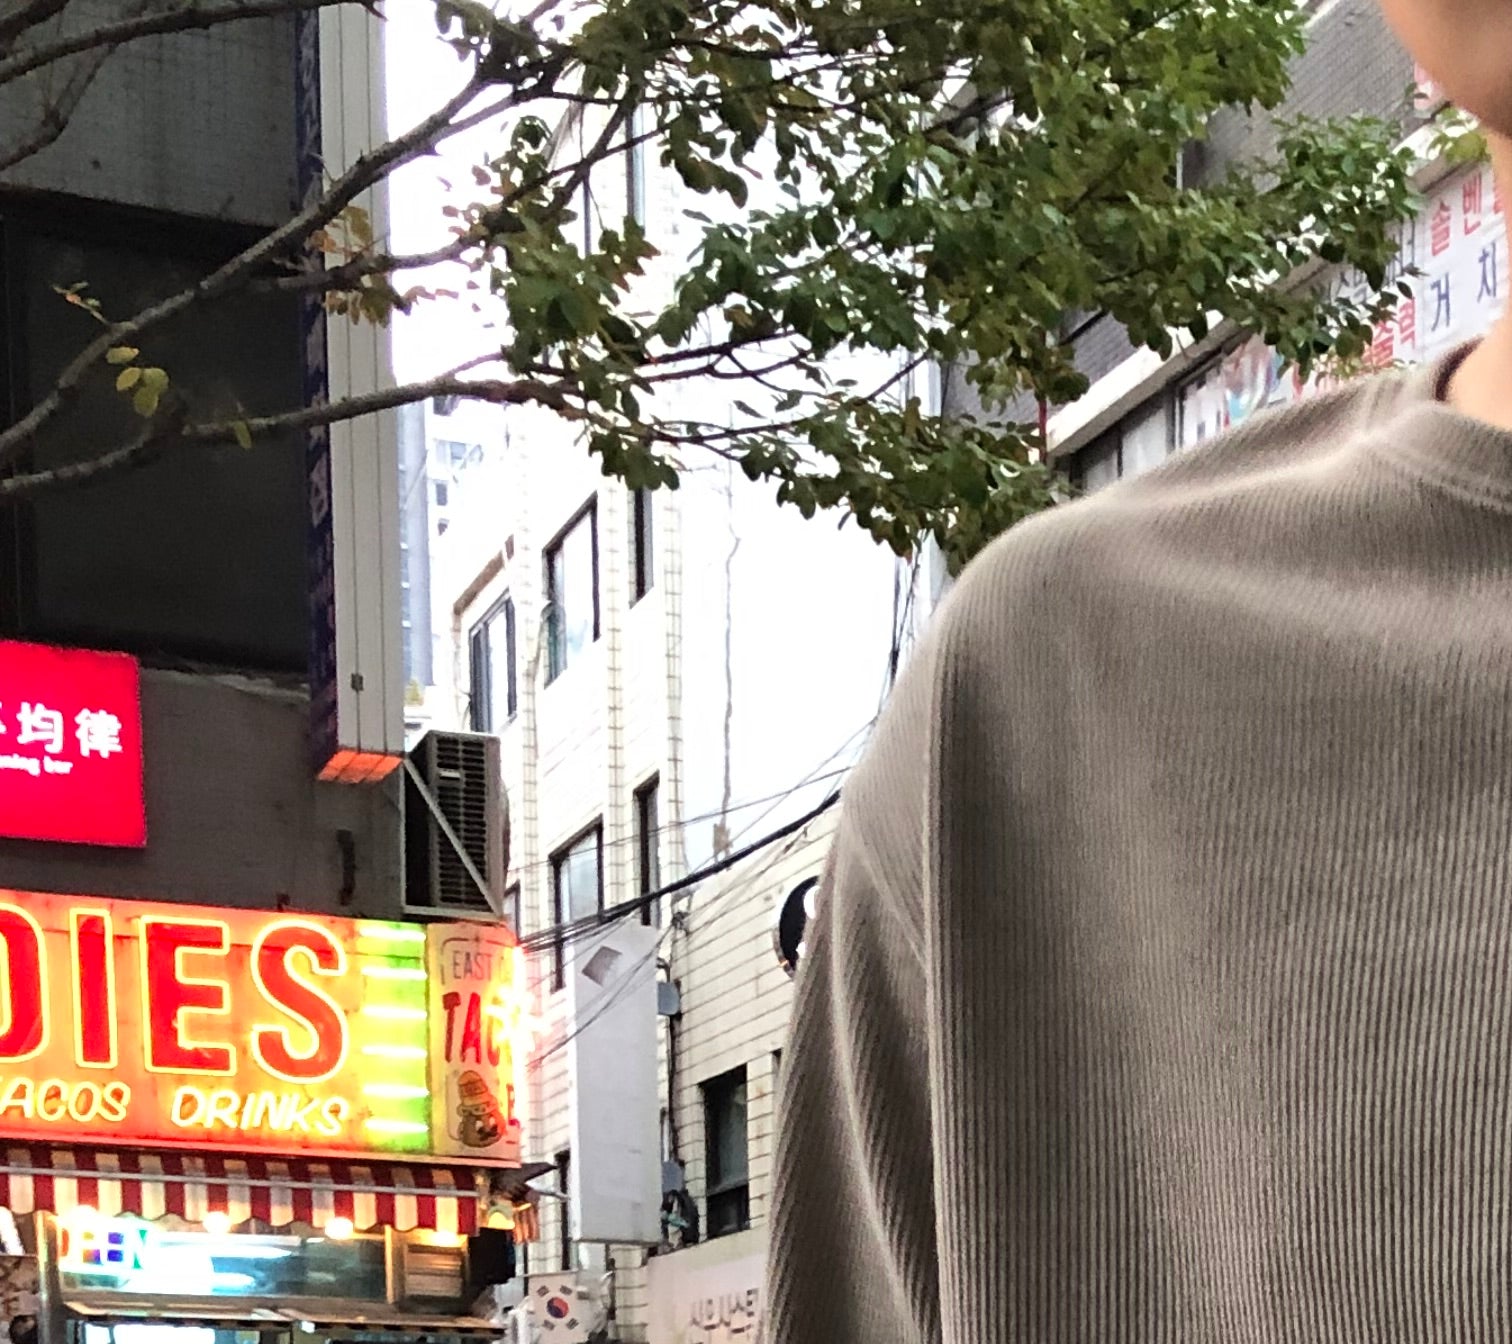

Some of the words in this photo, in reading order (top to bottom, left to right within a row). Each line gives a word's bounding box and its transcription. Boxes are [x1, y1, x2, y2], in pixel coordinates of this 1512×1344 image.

[0, 701, 122, 759] 均律
[452, 950, 493, 982] EAST
[0, 1076, 131, 1123] ACOS
[171, 1085, 350, 1136] DRINKS
